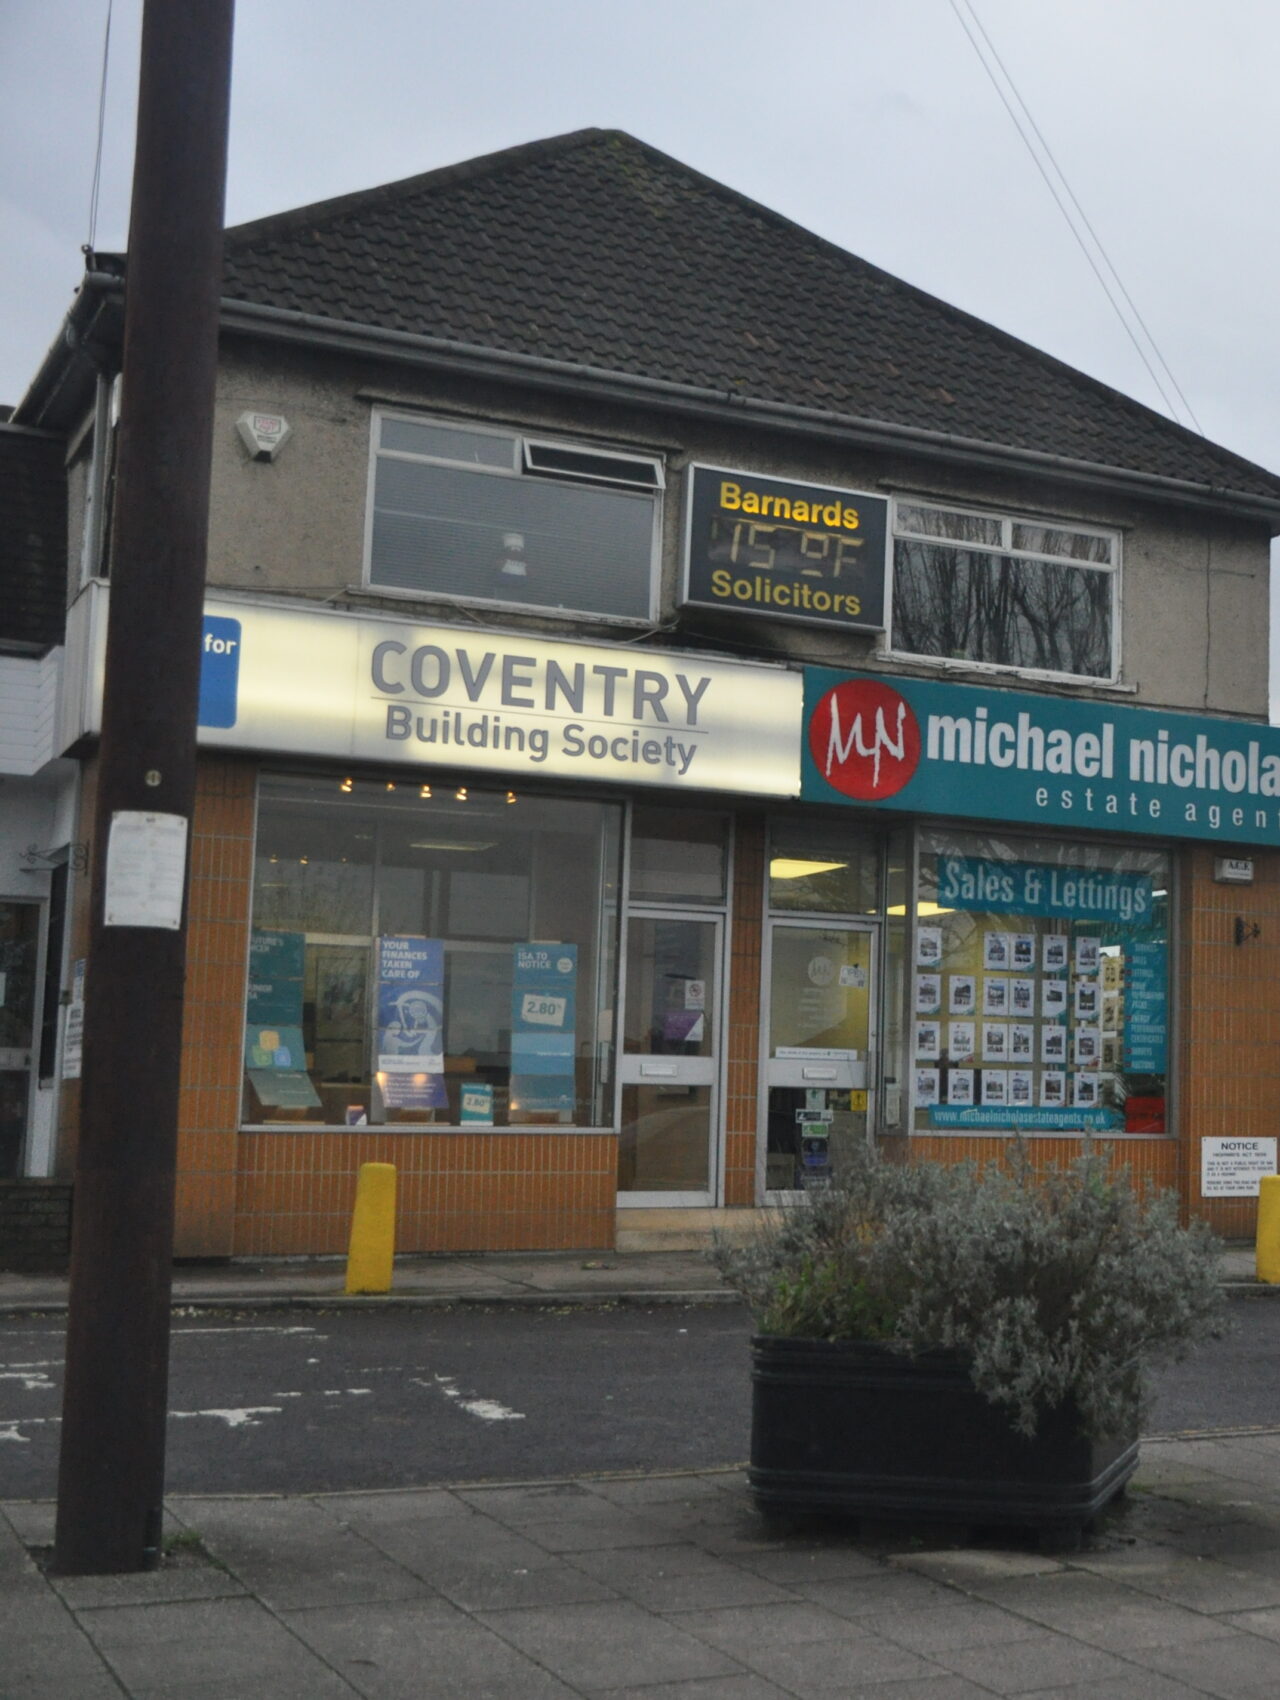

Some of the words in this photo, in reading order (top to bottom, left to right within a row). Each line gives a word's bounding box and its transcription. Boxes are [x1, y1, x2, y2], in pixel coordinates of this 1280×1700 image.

[720, 481, 860, 530] Barnards
[711, 569, 862, 616] Solicitors
[204, 632, 237, 656] for
[371, 640, 712, 726] COVENTRY
[385, 704, 549, 762] Building
[562, 724, 698, 775] Society
[927, 706, 1115, 780] michael
[1036, 787, 1161, 819] estate
[945, 859, 1015, 904] Sales
[1024, 872, 1043, 903] &
[1051, 873, 1148, 921] Lettings
[382, 951, 428, 960] FINANCES
[383, 941, 409, 950] YOUR
[518, 952, 534, 960] ISA
[535, 952, 548, 960] TO
[382, 969, 405, 978] CARE
[407, 970, 421, 979] OF
[383, 960, 413, 969] TAKEN
[518, 960, 552, 969] NOTICE
[1221, 1142, 1259, 1150] NOTICE
